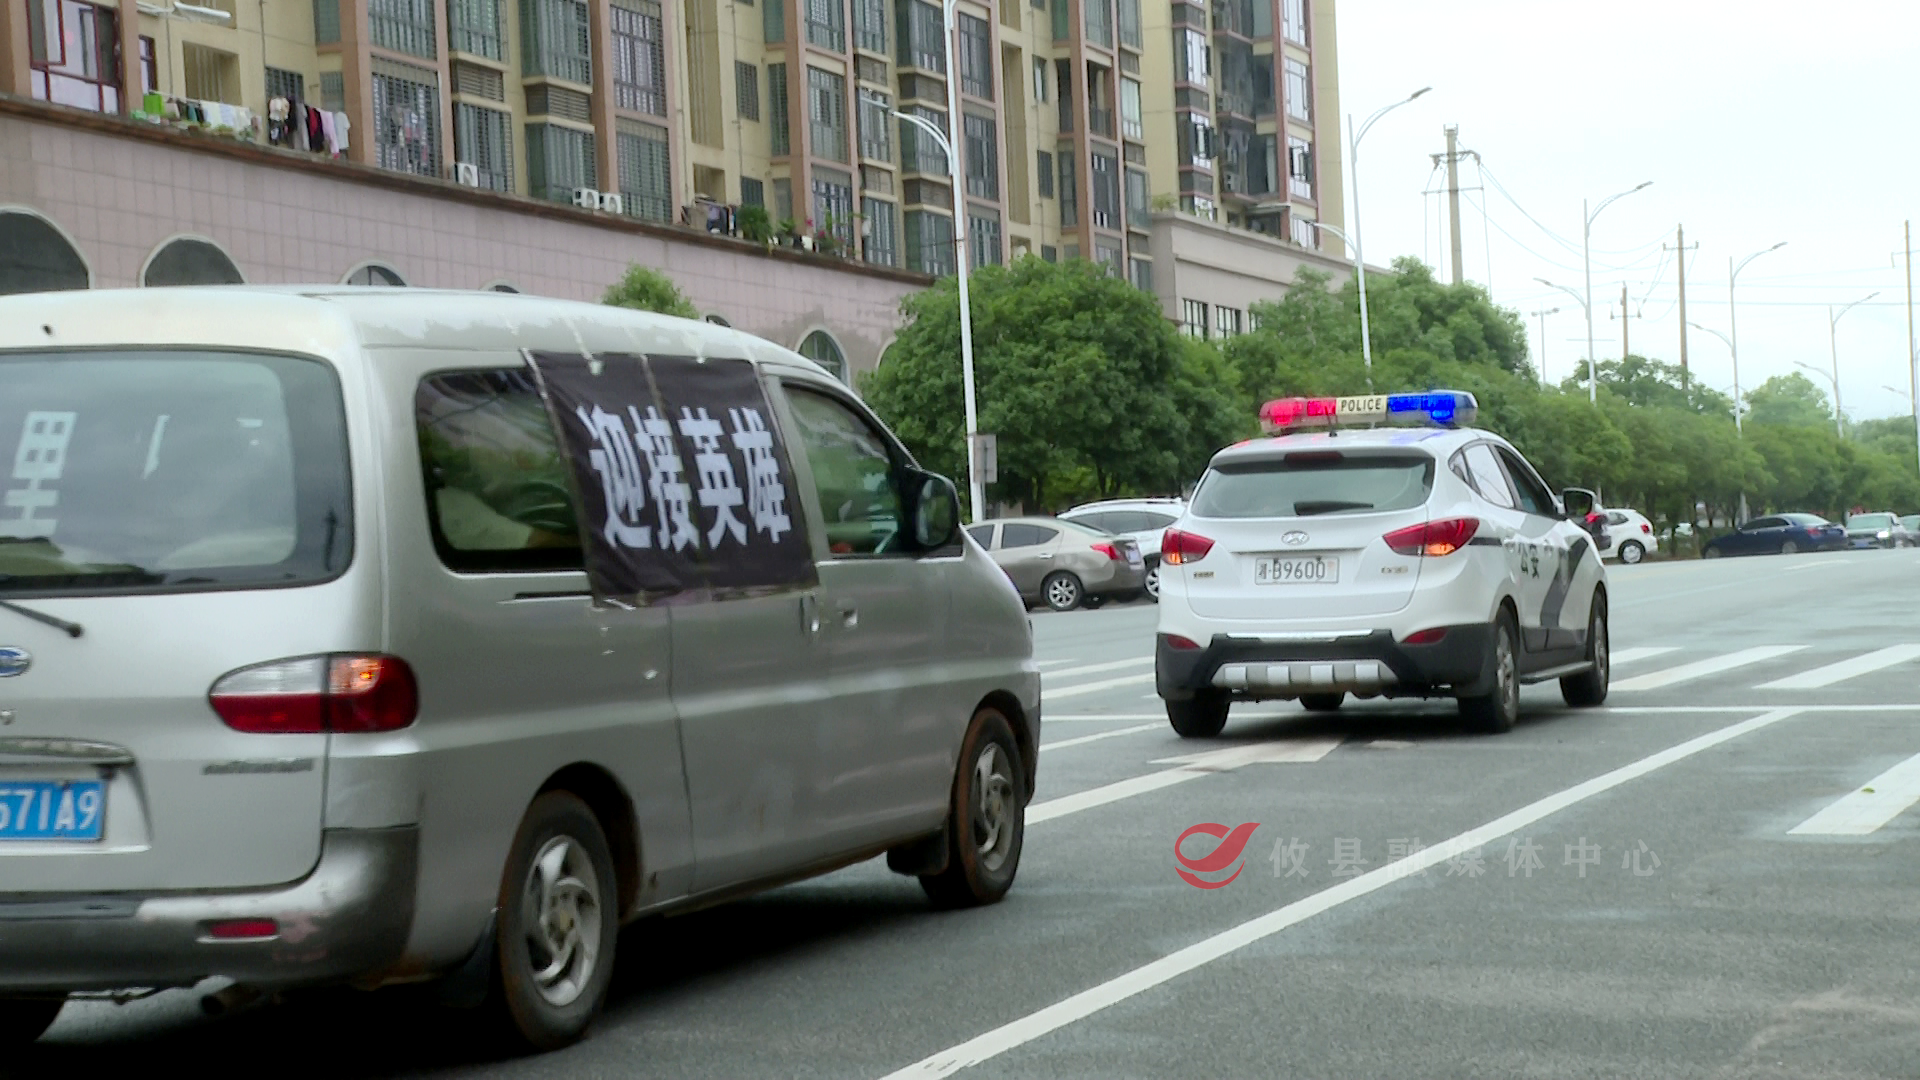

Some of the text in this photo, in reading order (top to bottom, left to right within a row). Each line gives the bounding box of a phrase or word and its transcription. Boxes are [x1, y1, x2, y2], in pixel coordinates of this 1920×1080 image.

[1341, 397, 1382, 412] POLICE
[576, 404, 792, 553] 迎接英雄
